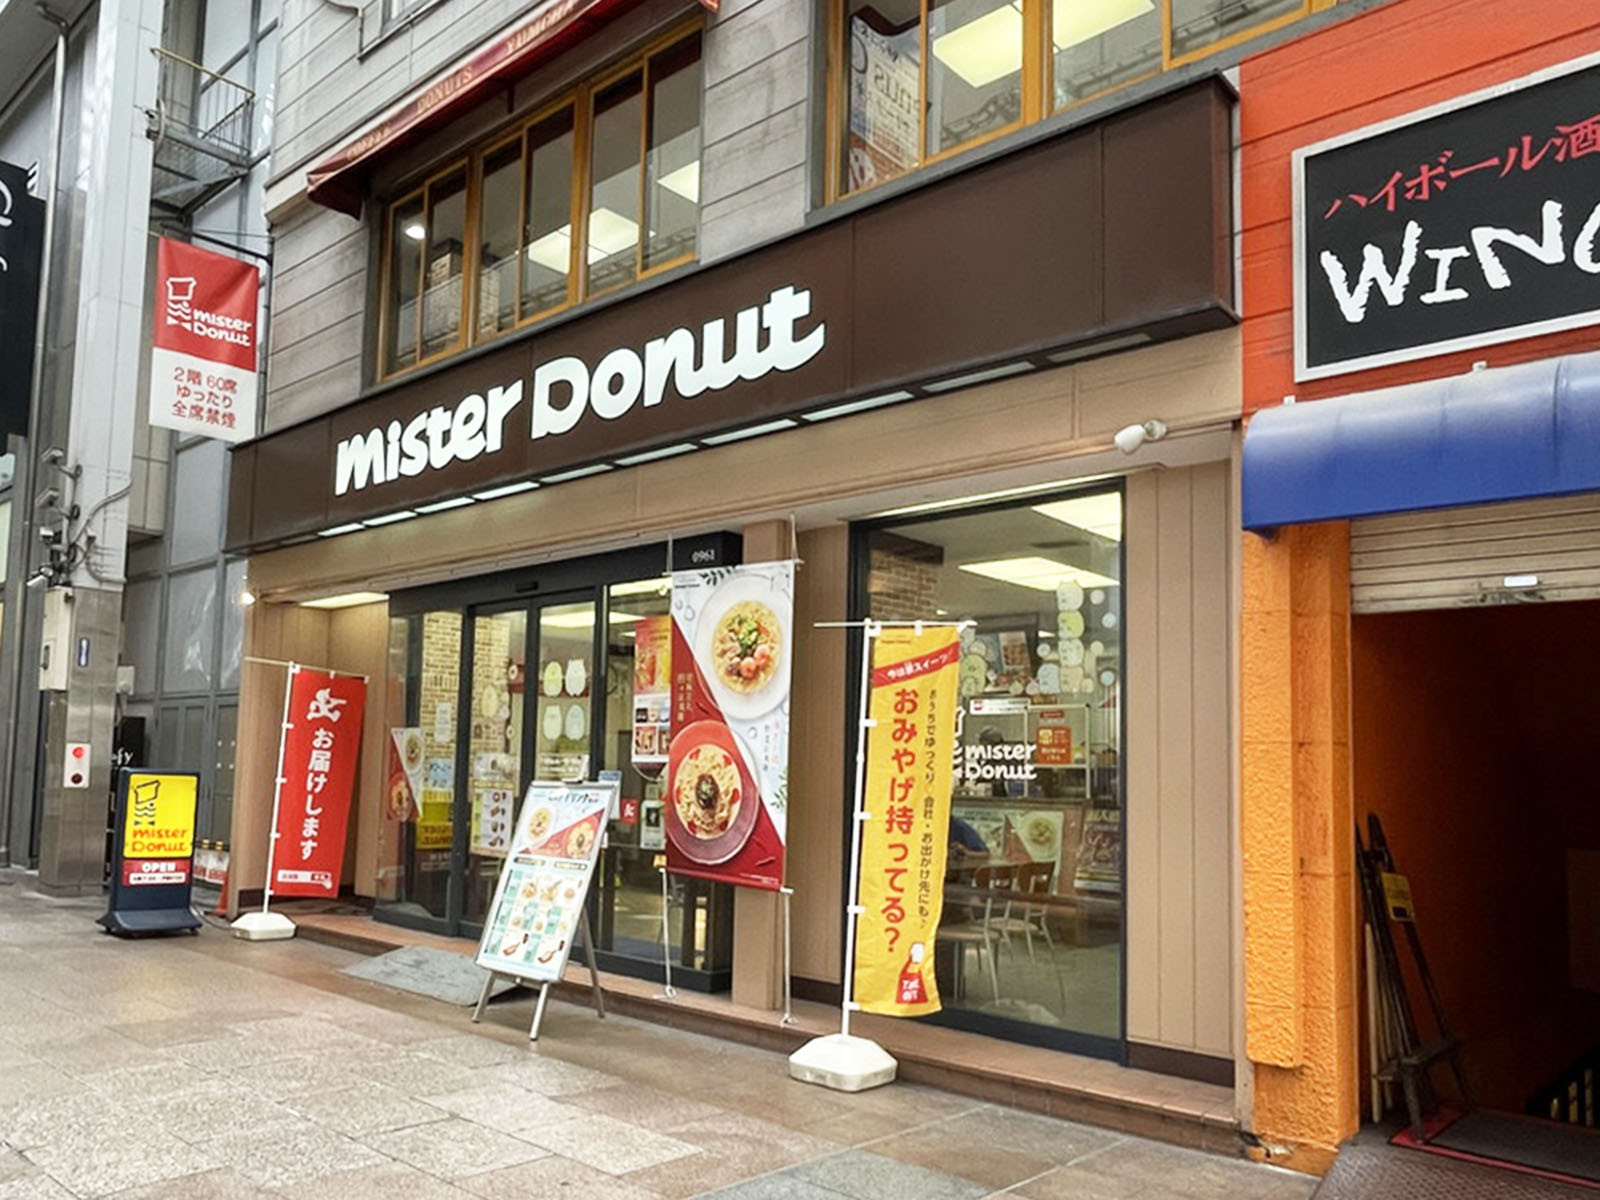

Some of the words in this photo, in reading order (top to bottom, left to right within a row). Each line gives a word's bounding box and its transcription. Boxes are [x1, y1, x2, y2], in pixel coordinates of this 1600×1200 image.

[193, 322, 252, 347] Donut
[532, 285, 825, 439] Donut
[176, 384, 233, 409] ゆったり
[172, 400, 237, 429] 全席禁煙
[965, 763, 1037, 780] Donut
[300, 727, 335, 860] お届けします
[881, 688, 919, 953] おみやげ持ってる？
[131, 841, 187, 852] Donut
[141, 862, 176, 872] OPEN
